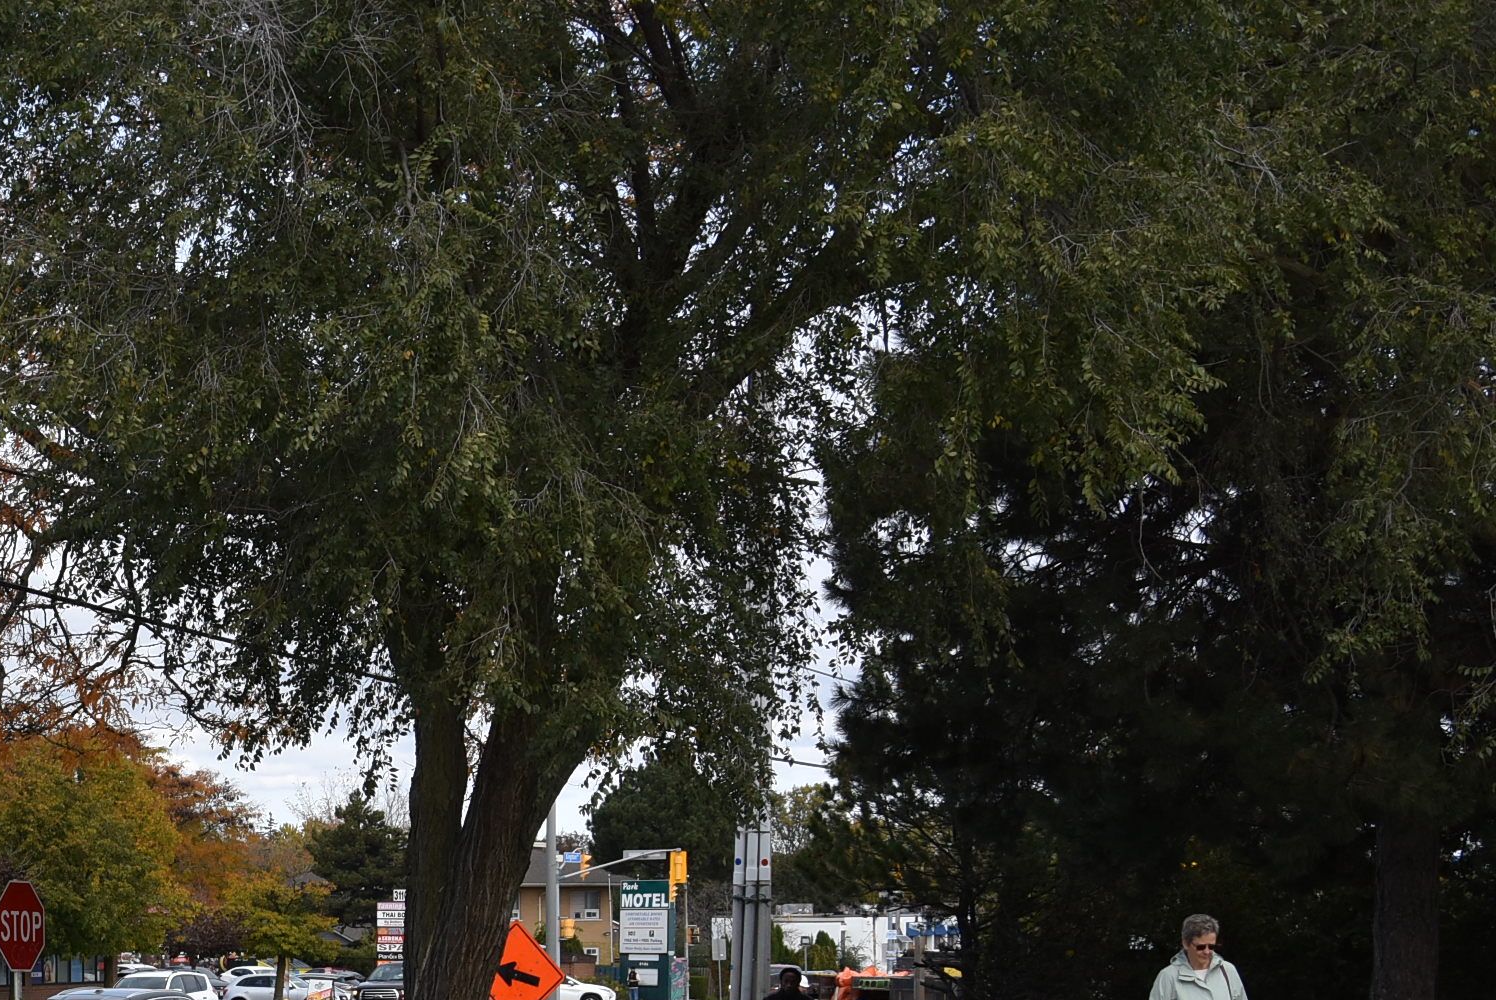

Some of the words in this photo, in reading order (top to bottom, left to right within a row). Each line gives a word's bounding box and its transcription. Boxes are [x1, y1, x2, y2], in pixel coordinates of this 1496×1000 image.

[622, 882, 639, 891] Park
[394, 890, 406, 901] 311
[621, 893, 669, 908] MOTEL
[0, 909, 42, 942] STOP
